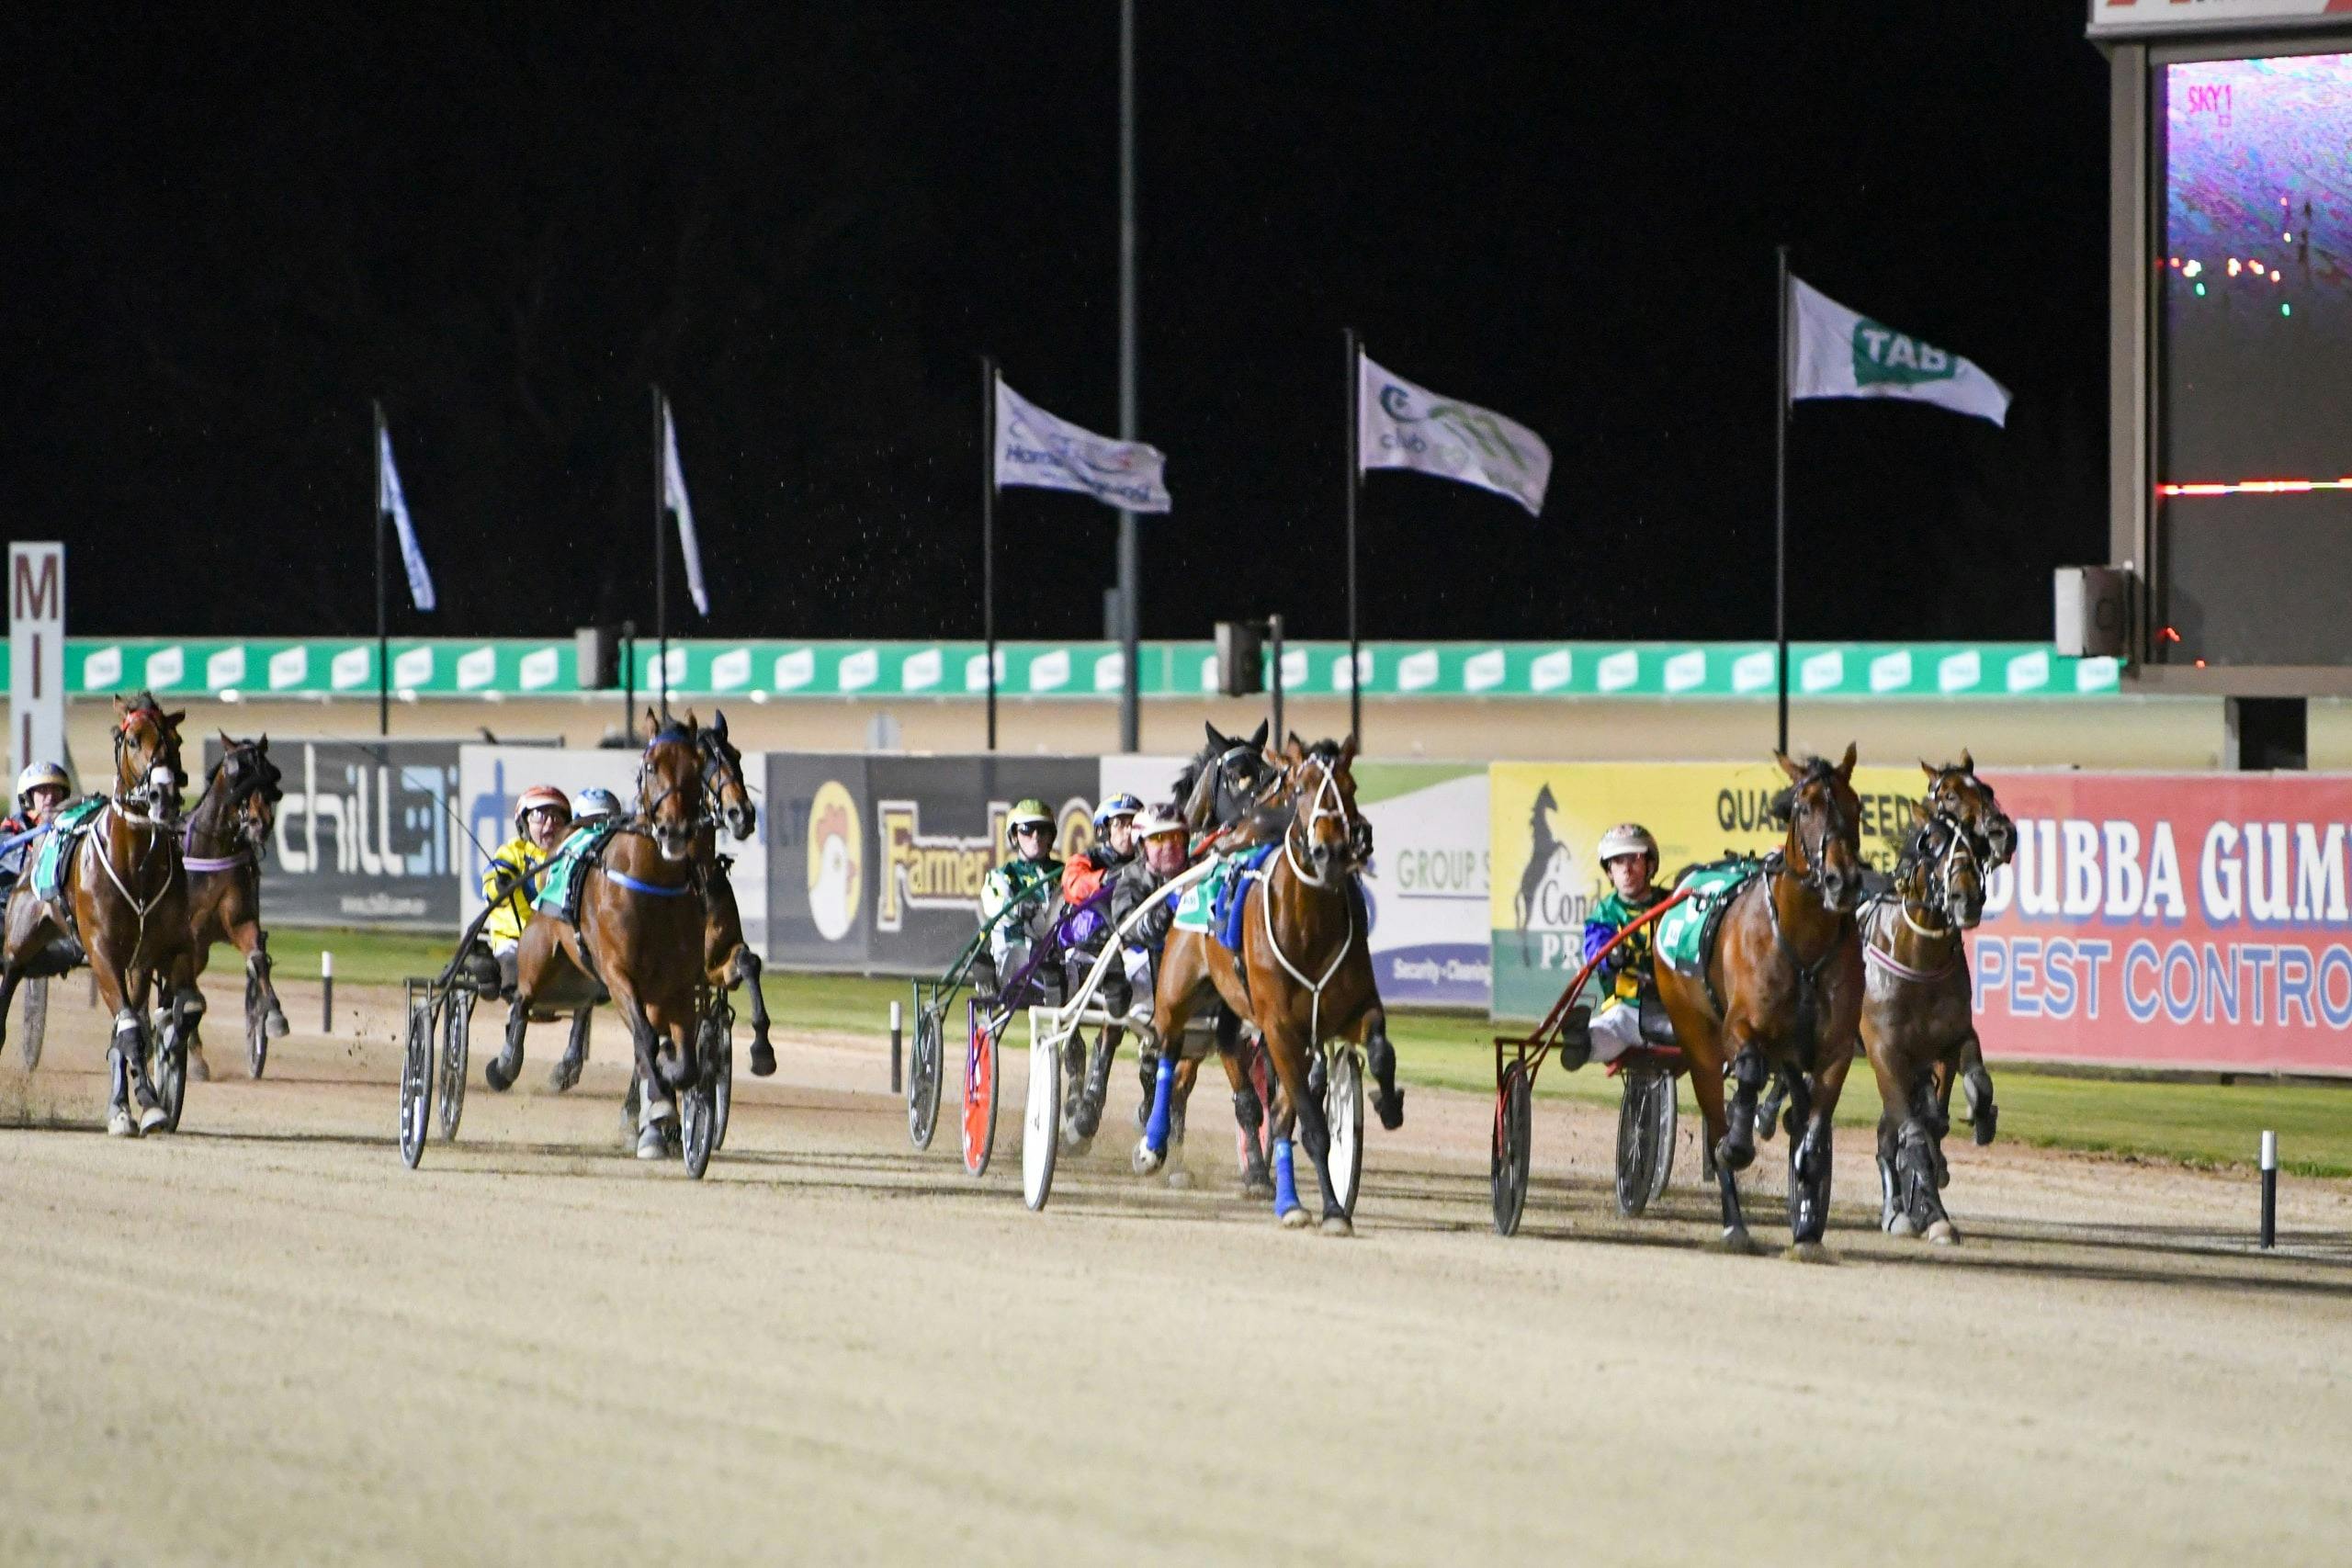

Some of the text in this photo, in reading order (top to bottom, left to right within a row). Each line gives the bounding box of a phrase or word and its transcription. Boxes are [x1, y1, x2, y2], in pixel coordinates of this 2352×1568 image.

[1862, 328, 1949, 372] TAB
[1717, 788, 1788, 832] QUA
[882, 809, 989, 919] Farmer
[1396, 849, 1476, 890] GROUP
[2201, 819, 2352, 920] GUM
[1974, 934, 2352, 1031] PEST CONTRO
